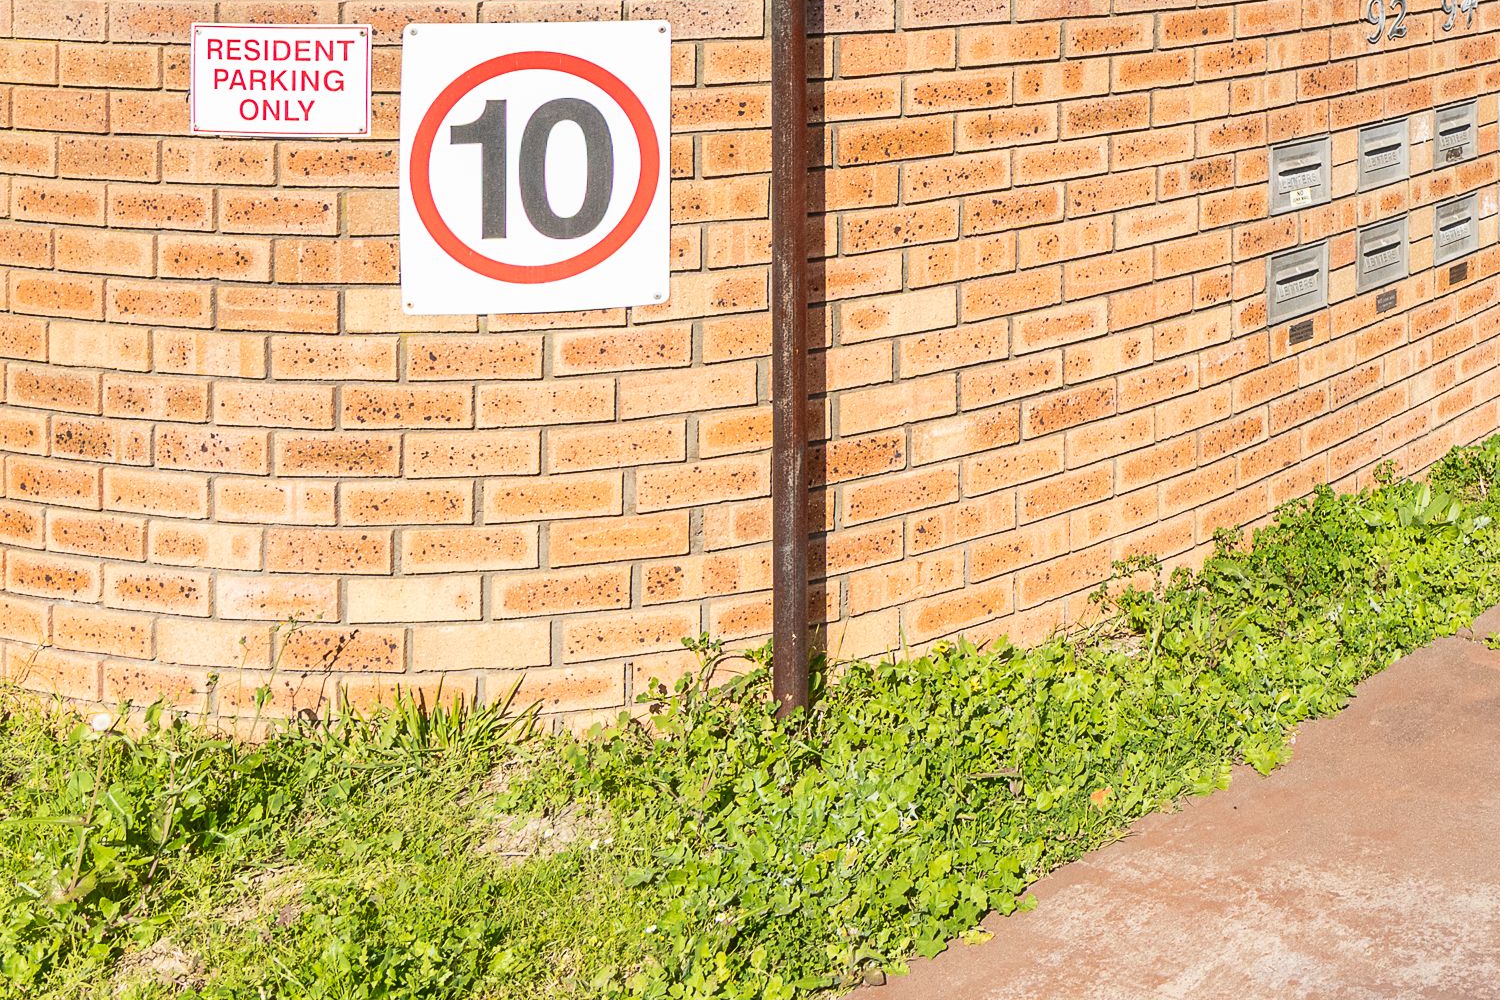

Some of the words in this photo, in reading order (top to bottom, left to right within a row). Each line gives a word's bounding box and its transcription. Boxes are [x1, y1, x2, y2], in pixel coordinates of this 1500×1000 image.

[206, 39, 355, 63] RESIDENT
[213, 69, 345, 92] PARKING
[239, 99, 316, 122] ONLY
[450, 97, 614, 240] 10
[1280, 172, 1317, 190] LETTERS
[1365, 250, 1398, 269] LETTERS
[1278, 278, 1315, 298] LETTERS
